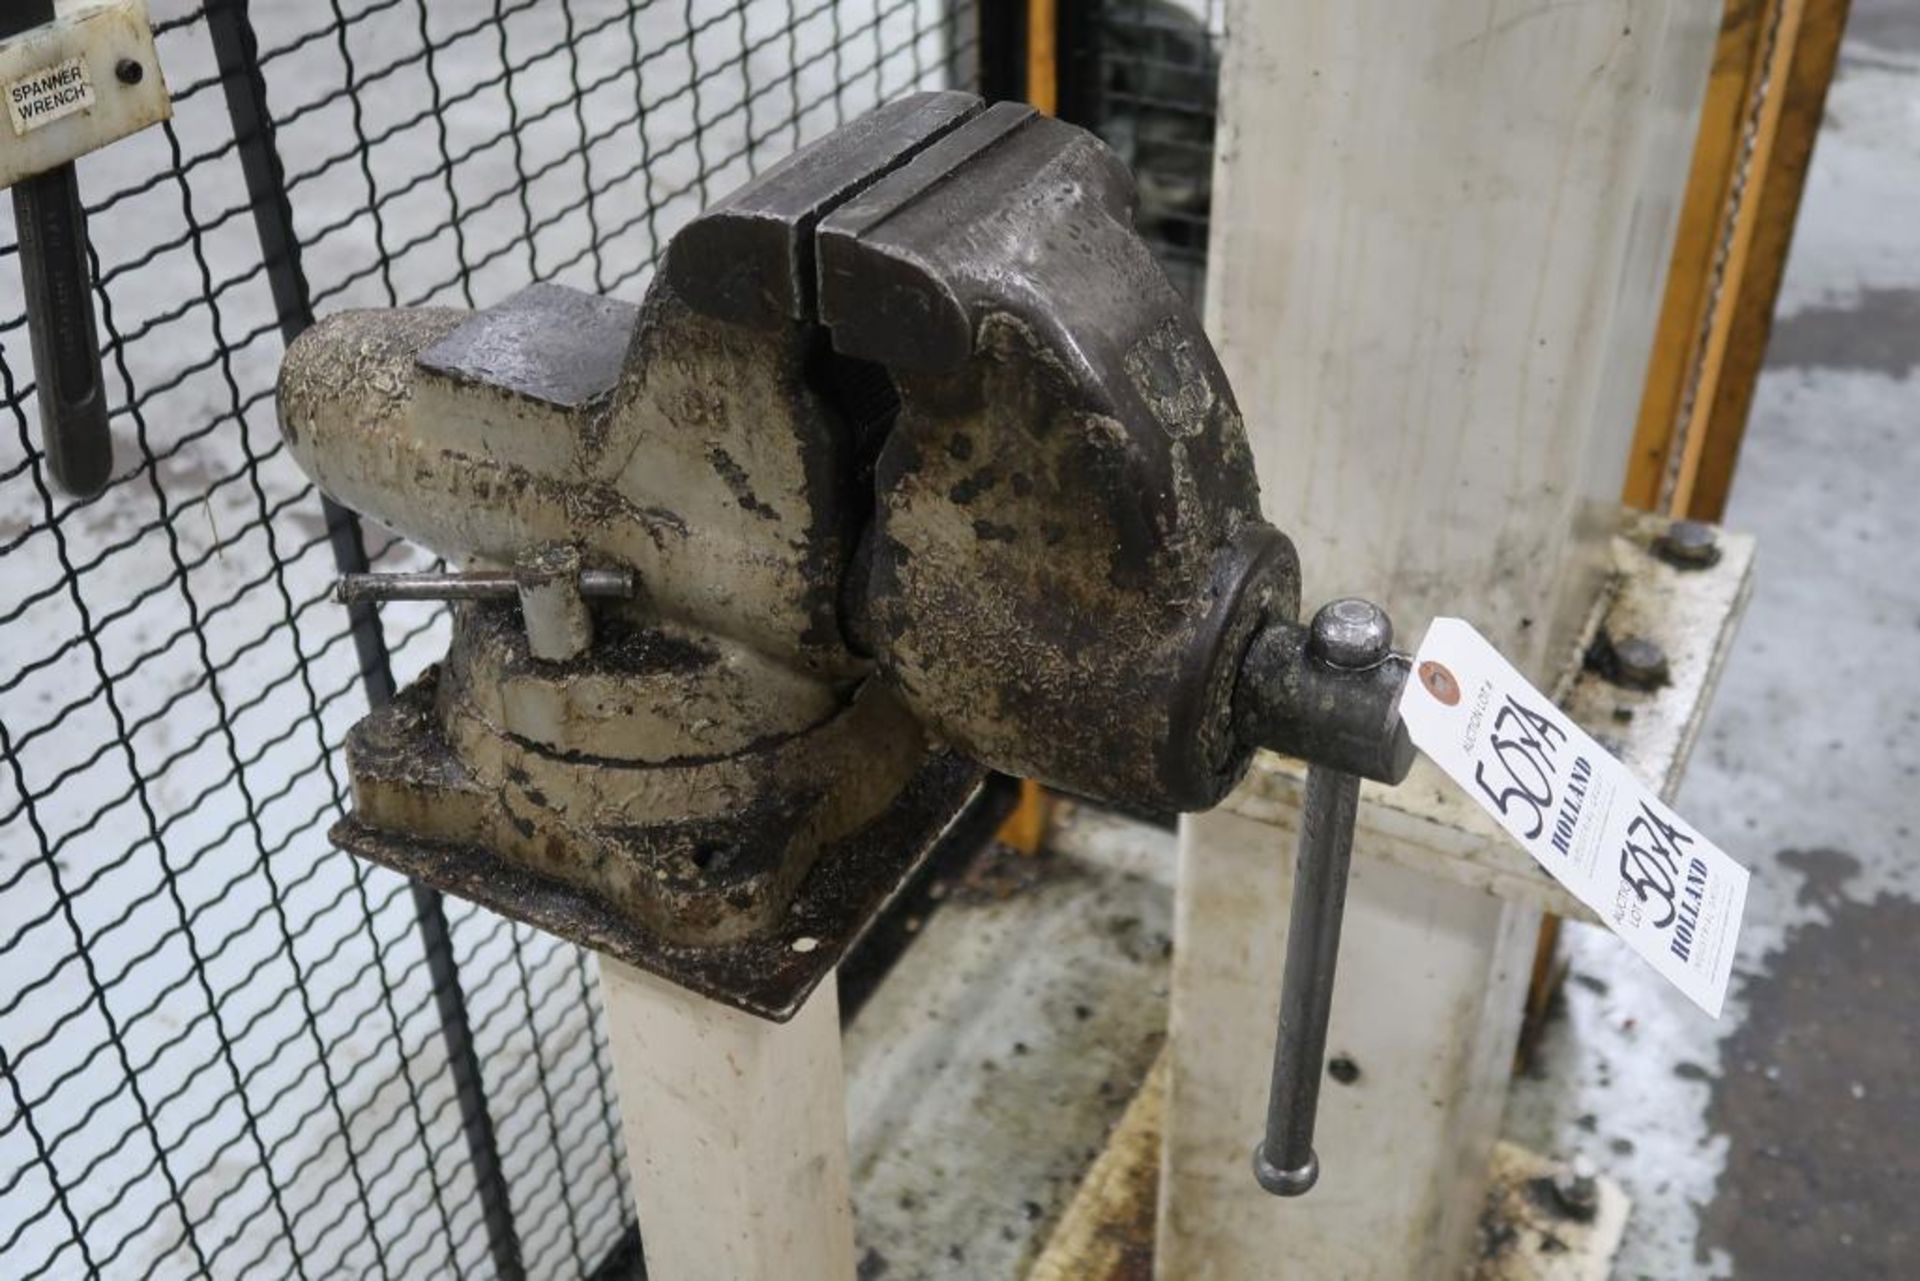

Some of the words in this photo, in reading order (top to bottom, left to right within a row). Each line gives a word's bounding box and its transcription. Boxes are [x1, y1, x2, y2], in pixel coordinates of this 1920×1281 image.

[12, 66, 83, 103] SPANNER
[18, 85, 86, 120] WRENCH
[1475, 694, 1567, 840] 507A
[1551, 756, 1592, 857] HOLLAND
[1620, 800, 1694, 929] 507A
[1670, 857, 1708, 962] HOLLAND
